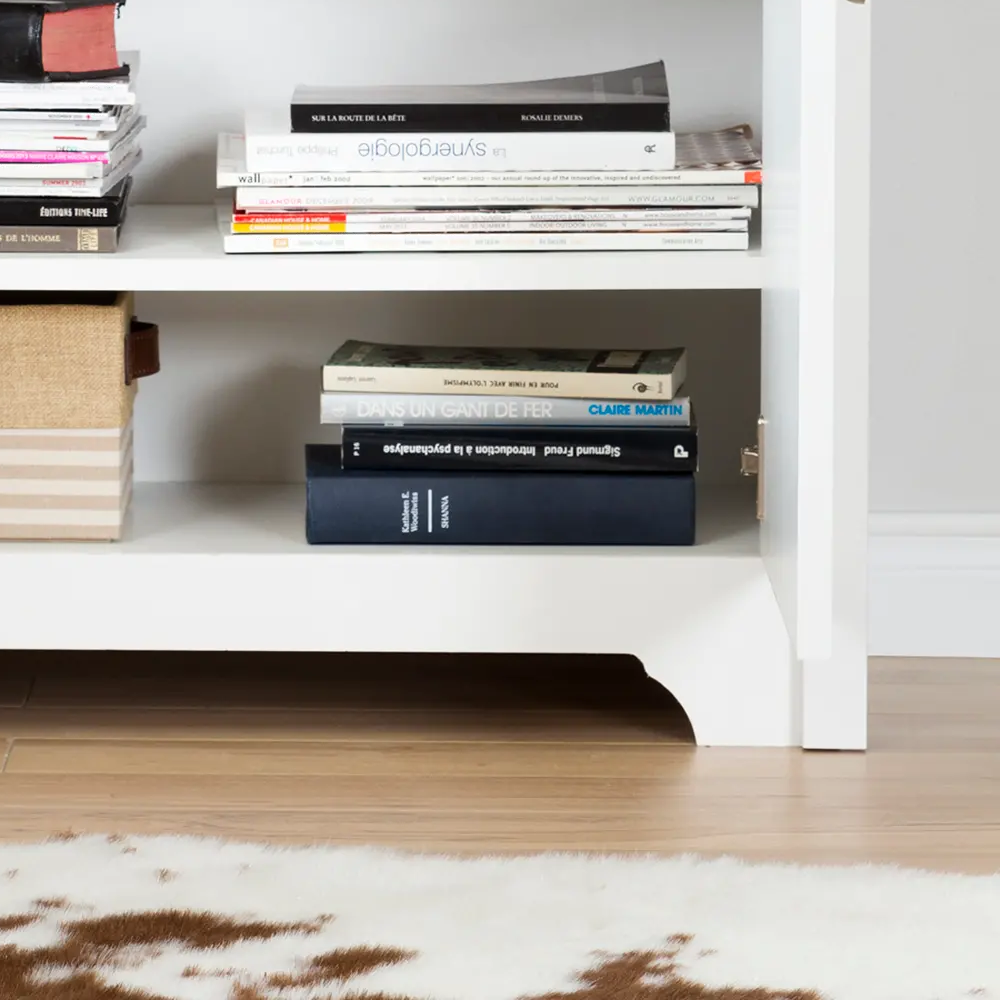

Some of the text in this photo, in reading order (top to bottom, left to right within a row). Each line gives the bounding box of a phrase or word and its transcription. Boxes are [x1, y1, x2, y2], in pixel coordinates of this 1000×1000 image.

[387, 113, 406, 122] BÊTE
[358, 138, 488, 161] synergologie
[39, 205, 108, 217] ÉDITIONS TIME-LIFE
[5, 234, 18, 242] DE
[20, 234, 61, 242] L'HOMME
[443, 379, 487, 387] L'OLYMPISME
[356, 401, 553, 418] DANS UN GANT DE FER
[588, 404, 683, 416] CLAIRE MARTIN
[382, 443, 536, 457] Introduction à la psychanalyse
[543, 444, 621, 457] Sigmund Freud
[401, 499, 410, 533] Kathleen
[440, 495, 450, 529] SHANNA
